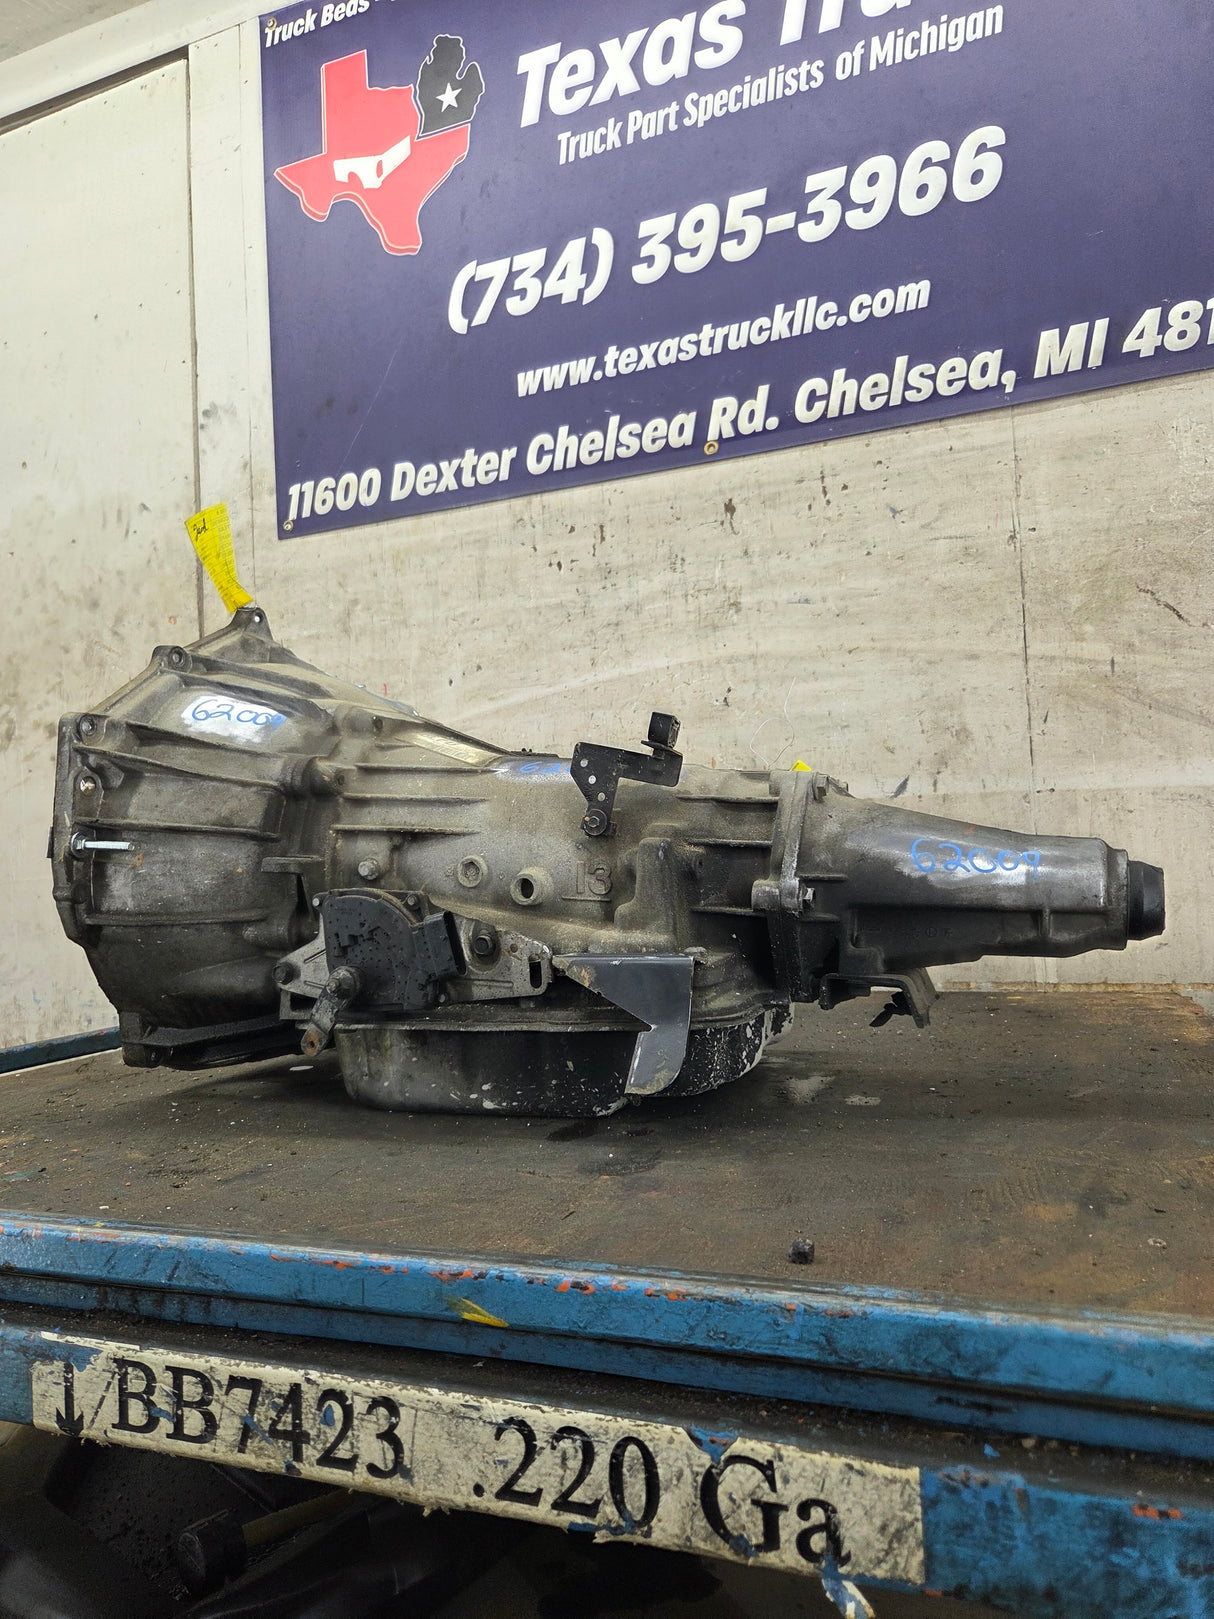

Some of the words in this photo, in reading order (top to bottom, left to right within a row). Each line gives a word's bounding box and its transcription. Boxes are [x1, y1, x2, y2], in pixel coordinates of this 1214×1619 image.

[264, 9, 318, 48] Truck
[516, 0, 747, 129] Texas
[557, 101, 623, 166] Truck
[627, 83, 681, 145] Part
[683, 59, 825, 129] Specialists
[836, 40, 866, 81] of
[869, 4, 1004, 73] Michigan
[447, 227, 614, 335] (734)
[631, 125, 1006, 285] 395-3966
[516, 279, 931, 398] www.texastruckllc.com
[288, 467, 382, 521] 11600
[390, 446, 518, 502] Dexter
[526, 410, 697, 477] Chelsea
[706, 384, 780, 442] Rd.
[794, 349, 1018, 424] Chelsea,
[1033, 317, 1110, 380] MI
[911, 837, 1041, 880] 62009
[699, 1454, 852, 1568] Ga
